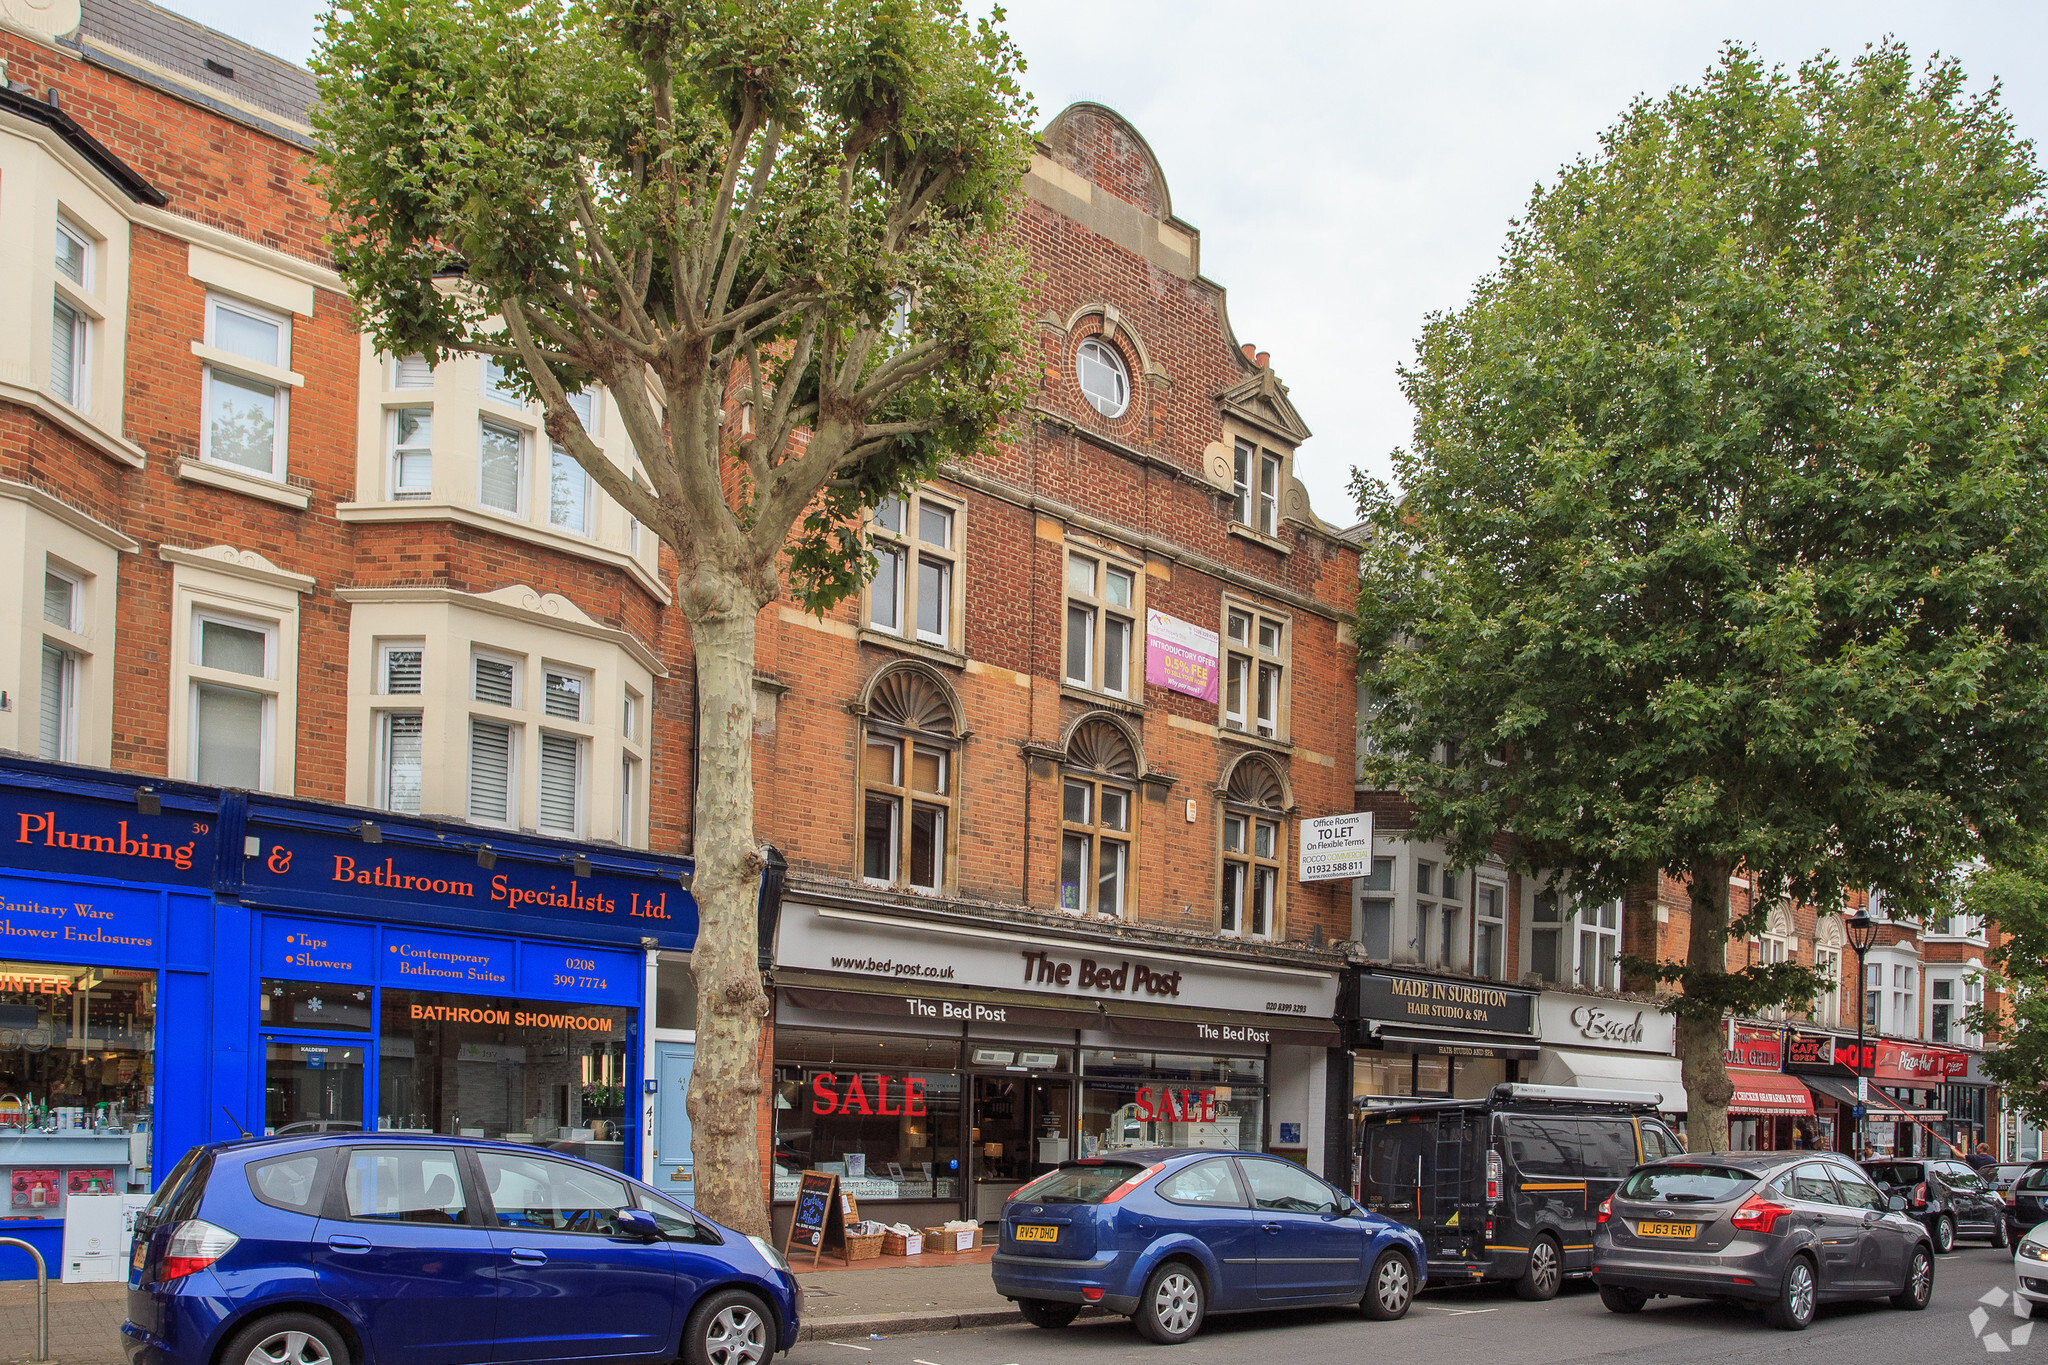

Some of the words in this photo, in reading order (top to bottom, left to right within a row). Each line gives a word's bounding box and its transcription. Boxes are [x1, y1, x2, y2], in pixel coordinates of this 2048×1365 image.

[1150, 639, 1197, 661] INTRODUCTORY
[1198, 656, 1215, 668] OFFER
[1165, 655, 1189, 674] 0.5%
[1191, 664, 1208, 680] FEE
[1168, 678, 1178, 687] Why
[1178, 682, 1187, 690] pay
[1182, 673, 1194, 683] YOUR
[191, 822, 209, 836] 39
[1313, 819, 1334, 828] Office
[1335, 816, 1359, 825] Rooms
[16, 811, 195, 871] Plumbing
[1318, 829, 1332, 840] TO
[1335, 826, 1354, 838] LET
[1318, 840, 1344, 849] Flexible
[1344, 838, 1365, 846] Terms
[1302, 855, 1326, 863] ROCCO
[1327, 850, 1368, 861] COMMERCIAL
[1307, 864, 1331, 874] 01932
[1332, 862, 1347, 872] 588
[1348, 861, 1363, 870] 811
[267, 845, 293, 874] &
[332, 855, 474, 897] Bathroom
[491, 874, 615, 914] Specialists
[630, 892, 672, 919] Ltd.
[74, 903, 114, 919] Ware
[64, 926, 153, 947] Enclosures
[296, 932, 328, 949] Taps
[296, 953, 352, 970] Showers
[400, 944, 490, 966] Contemporary
[400, 961, 464, 979] Bathroom
[468, 967, 505, 983] Suites
[566, 957, 595, 971] 0208
[831, 956, 955, 979] www.bed-post.co.uk
[553, 974, 575, 987] 399
[578, 976, 608, 990] 7774
[1022, 951, 1072, 985] The
[1078, 958, 1129, 992] Bed
[1132, 964, 1182, 996] Post
[1391, 979, 1429, 999] MADE
[1432, 983, 1446, 1001] IN
[1448, 985, 1507, 1008] SURBITON
[906, 999, 937, 1017] The
[943, 1002, 972, 1019] Bed
[975, 1005, 1006, 1022] Post
[1266, 1002, 1277, 1010] 020
[1407, 1002, 1430, 1016] HAIR
[1431, 1004, 1464, 1020] STUDIO
[1465, 1010, 1472, 1020] &
[1472, 1009, 1488, 1022] SPA
[411, 1005, 510, 1025] BATHROOM
[514, 1012, 612, 1032] SHOWROOM
[1581, 1007, 1644, 1044] Beach
[1197, 1024, 1219, 1039] The
[1223, 1026, 1245, 1041] Bed
[1247, 1028, 1270, 1042] Post
[1438, 1046, 1453, 1054] HAIR
[1454, 1047, 1472, 1055] STUDIO
[1473, 1048, 1484, 1056] AND
[1485, 1049, 1494, 1057] SPA
[1791, 1043, 1820, 1054] CAFE
[1748, 1049, 1778, 1067] GRILL
[1792, 1054, 1816, 1062] OPEN
[1898, 1050, 1919, 1071] Pizza
[1919, 1053, 1935, 1072] Hut
[812, 1073, 927, 1117] SALE
[1737, 1091, 1759, 1102] CHICKEN
[1759, 1092, 1786, 1103] SHAWARMA
[1786, 1094, 1792, 1103] IN
[1792, 1094, 1806, 1104] TOWN
[1135, 1087, 1217, 1123] SALE
[775, 1189, 795, 1197] Pillows
[1019, 1226, 1038, 1238] RV57
[1642, 1224, 1668, 1235] LJ63
[1671, 1225, 1692, 1236] ENR
